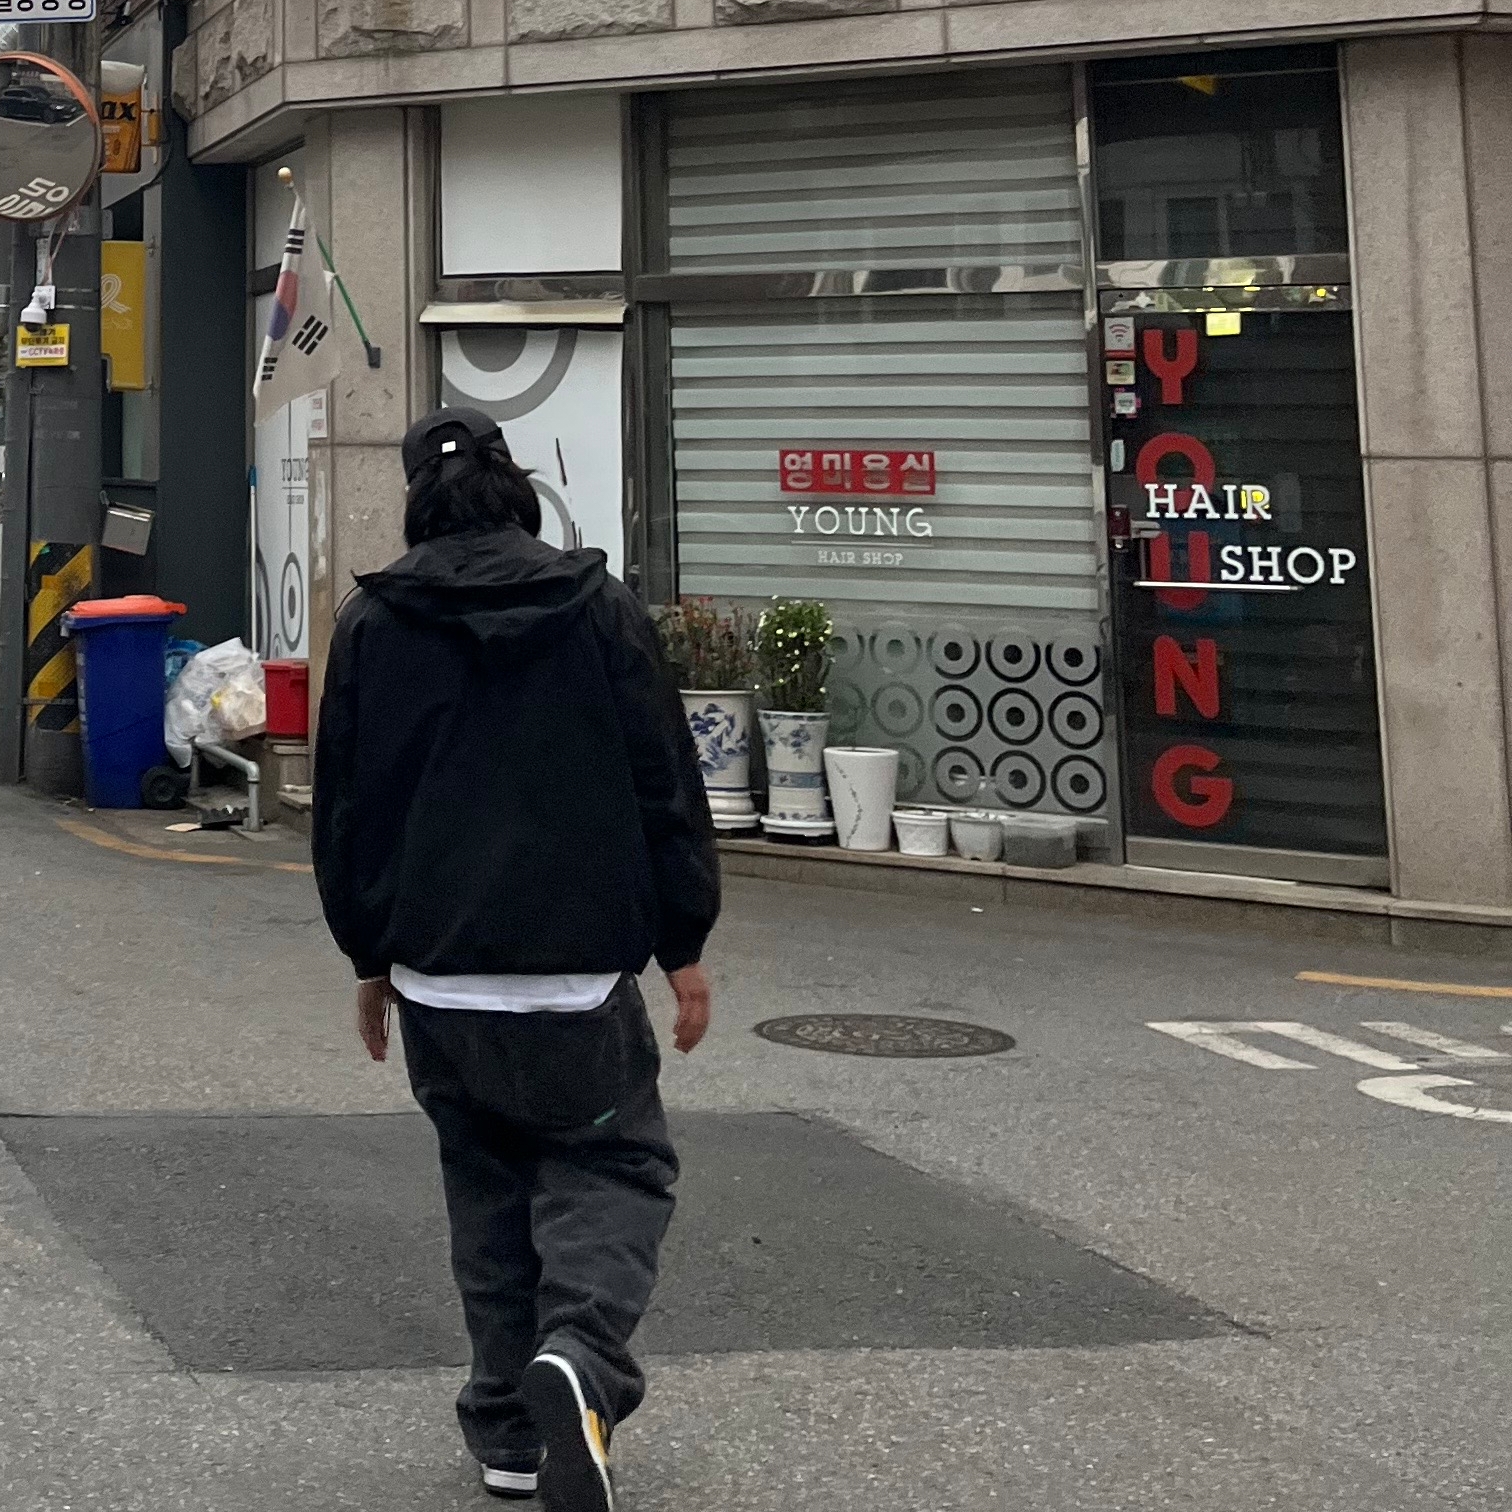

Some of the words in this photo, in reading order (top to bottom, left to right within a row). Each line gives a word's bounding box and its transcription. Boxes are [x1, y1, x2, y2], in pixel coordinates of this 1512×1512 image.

[784, 452, 931, 492] 영미용실
[1145, 483, 1272, 520] HAIR
[787, 505, 933, 537] YOUNG
[818, 551, 856, 564] HAIR
[861, 552, 904, 566] SHOP
[1220, 545, 1356, 585] SHOP
[1136, 329, 1233, 827] YOUNG
